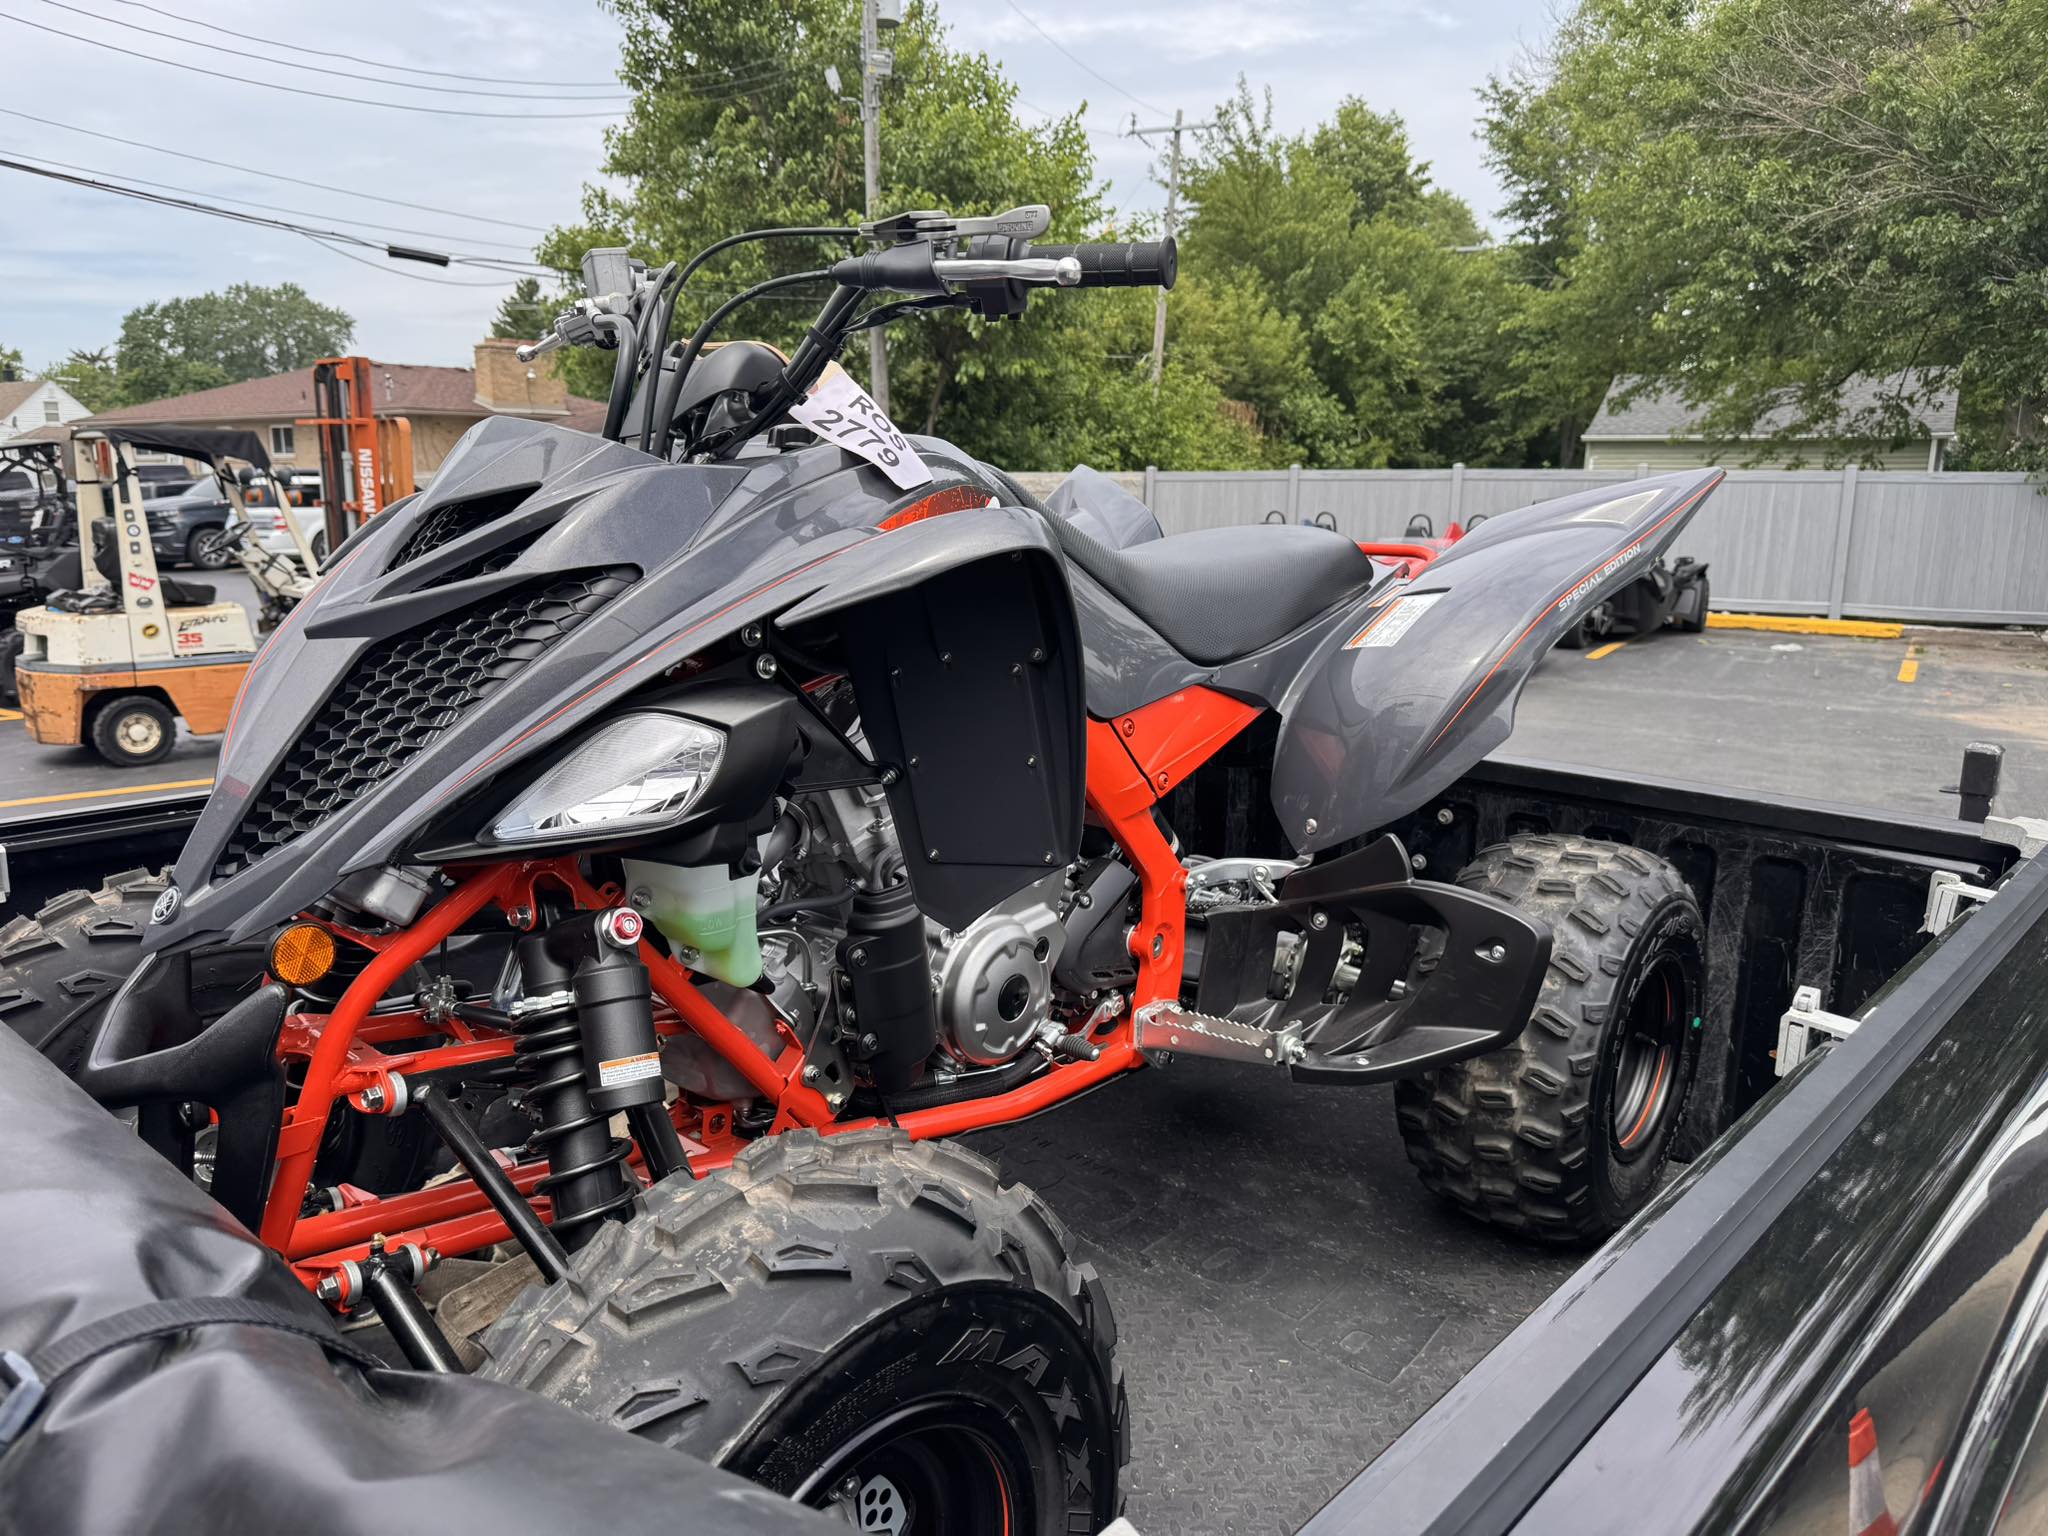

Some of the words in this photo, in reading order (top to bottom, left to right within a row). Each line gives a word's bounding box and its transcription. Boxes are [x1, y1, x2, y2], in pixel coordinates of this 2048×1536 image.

[812, 409, 900, 467] 2779
[848, 395, 907, 451] ROS
[358, 448, 376, 513] NISSAN
[1558, 574, 1602, 612] SPECIAL
[1603, 543, 1641, 576] EDITION
[177, 633, 203, 643] 35
